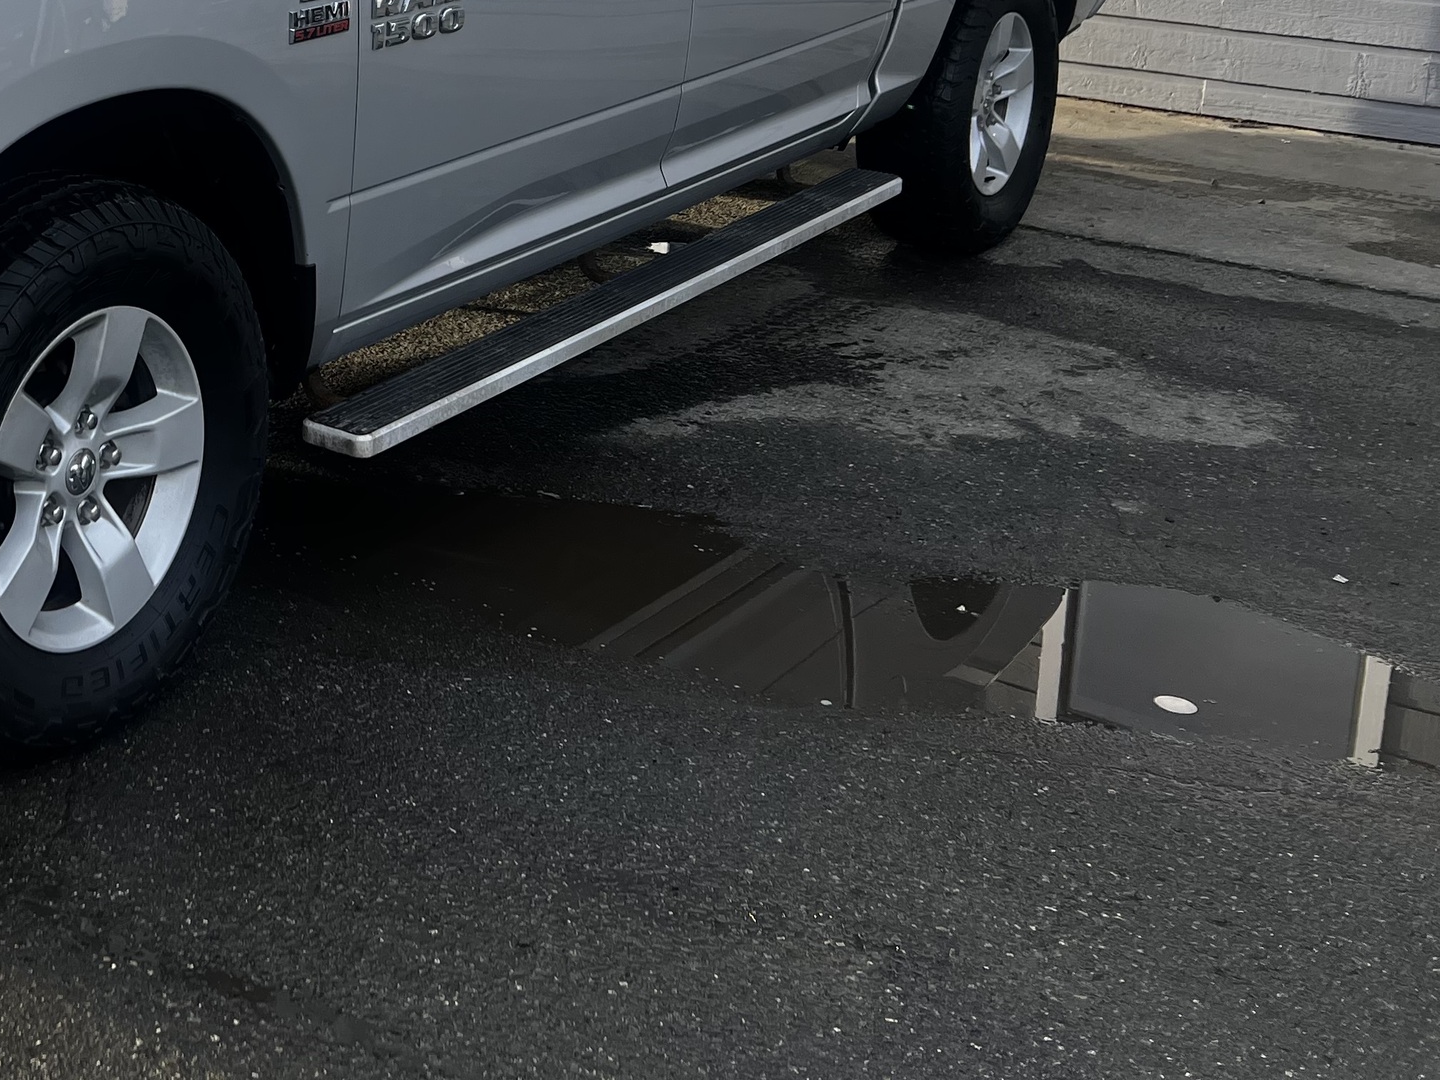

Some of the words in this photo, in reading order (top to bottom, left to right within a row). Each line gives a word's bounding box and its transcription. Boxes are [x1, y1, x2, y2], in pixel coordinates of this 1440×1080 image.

[289, 1, 350, 29] HEMI
[317, 21, 349, 37] LITER
[371, 5, 465, 51] 1500
